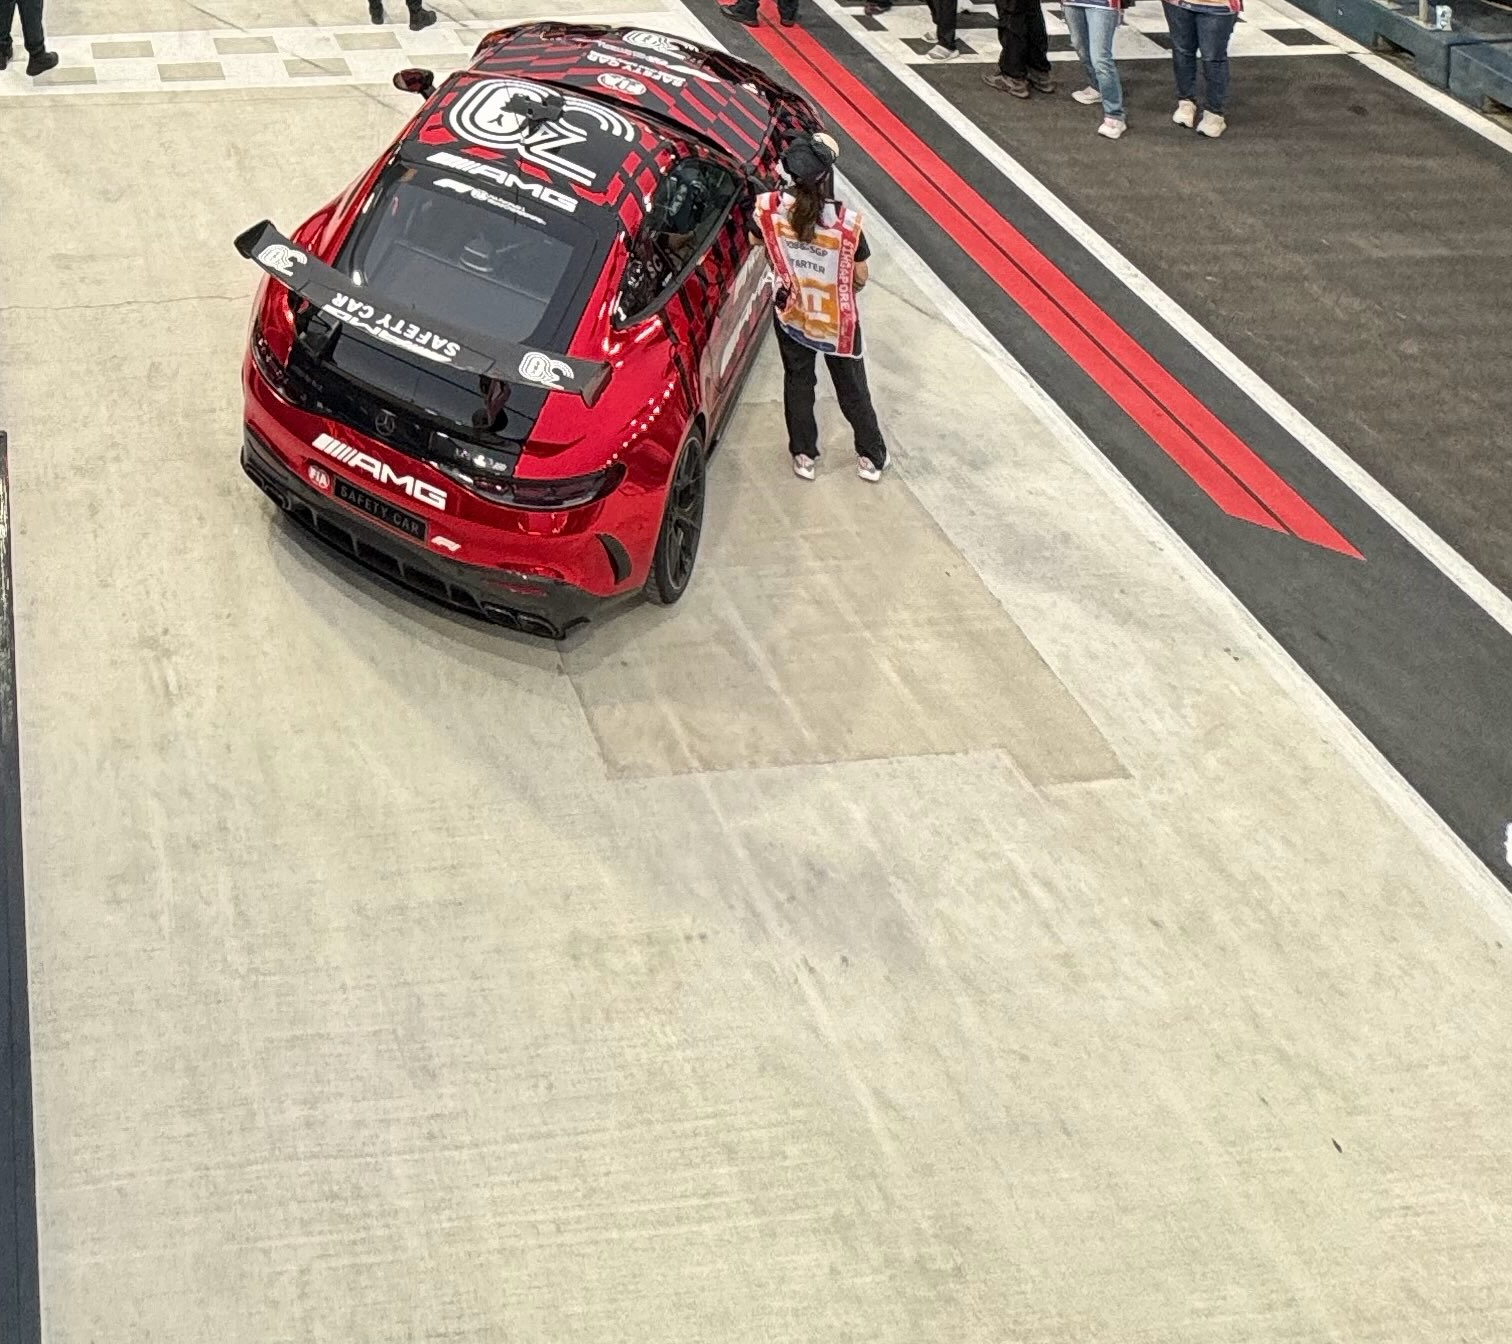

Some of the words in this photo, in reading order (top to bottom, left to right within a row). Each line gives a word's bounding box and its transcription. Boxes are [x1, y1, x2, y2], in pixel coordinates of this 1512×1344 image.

[840, 238, 855, 312] SINGAPORE
[331, 292, 376, 320] CAR
[376, 312, 461, 358] SAFETY
[348, 452, 448, 511] AMG
[339, 483, 390, 519] SAFETY
[392, 513, 420, 536] CAR
